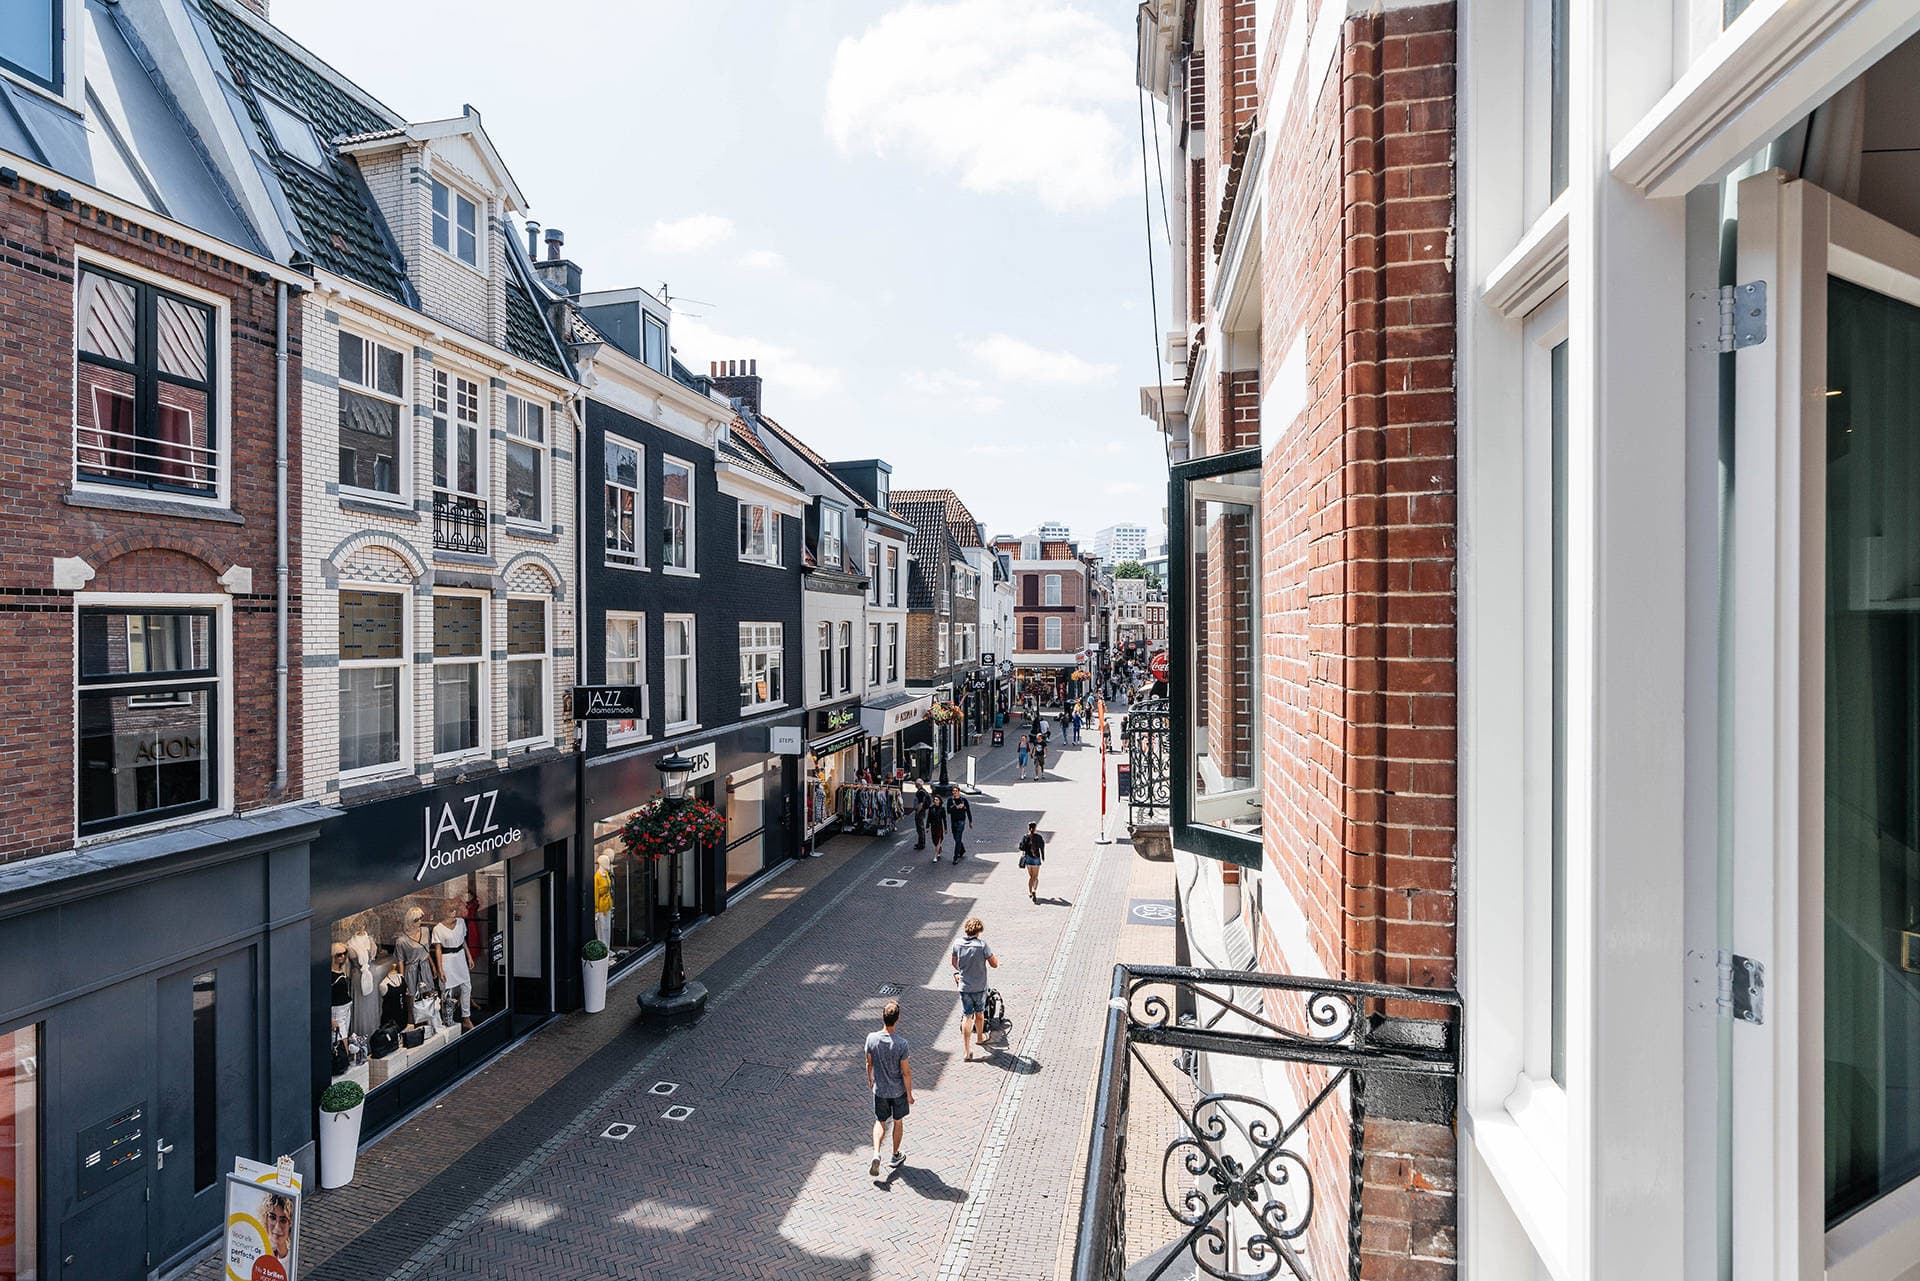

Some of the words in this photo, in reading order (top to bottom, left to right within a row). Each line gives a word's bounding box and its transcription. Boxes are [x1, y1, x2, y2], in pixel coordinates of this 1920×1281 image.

[971, 681, 986, 689] Lee
[585, 690, 622, 716] JAZZ
[591, 706, 634, 714] damesmode
[688, 752, 710, 774] EPS
[416, 789, 500, 882] JAZZ
[429, 827, 521, 870] damesmode
[231, 1248, 255, 1261] perfecte
